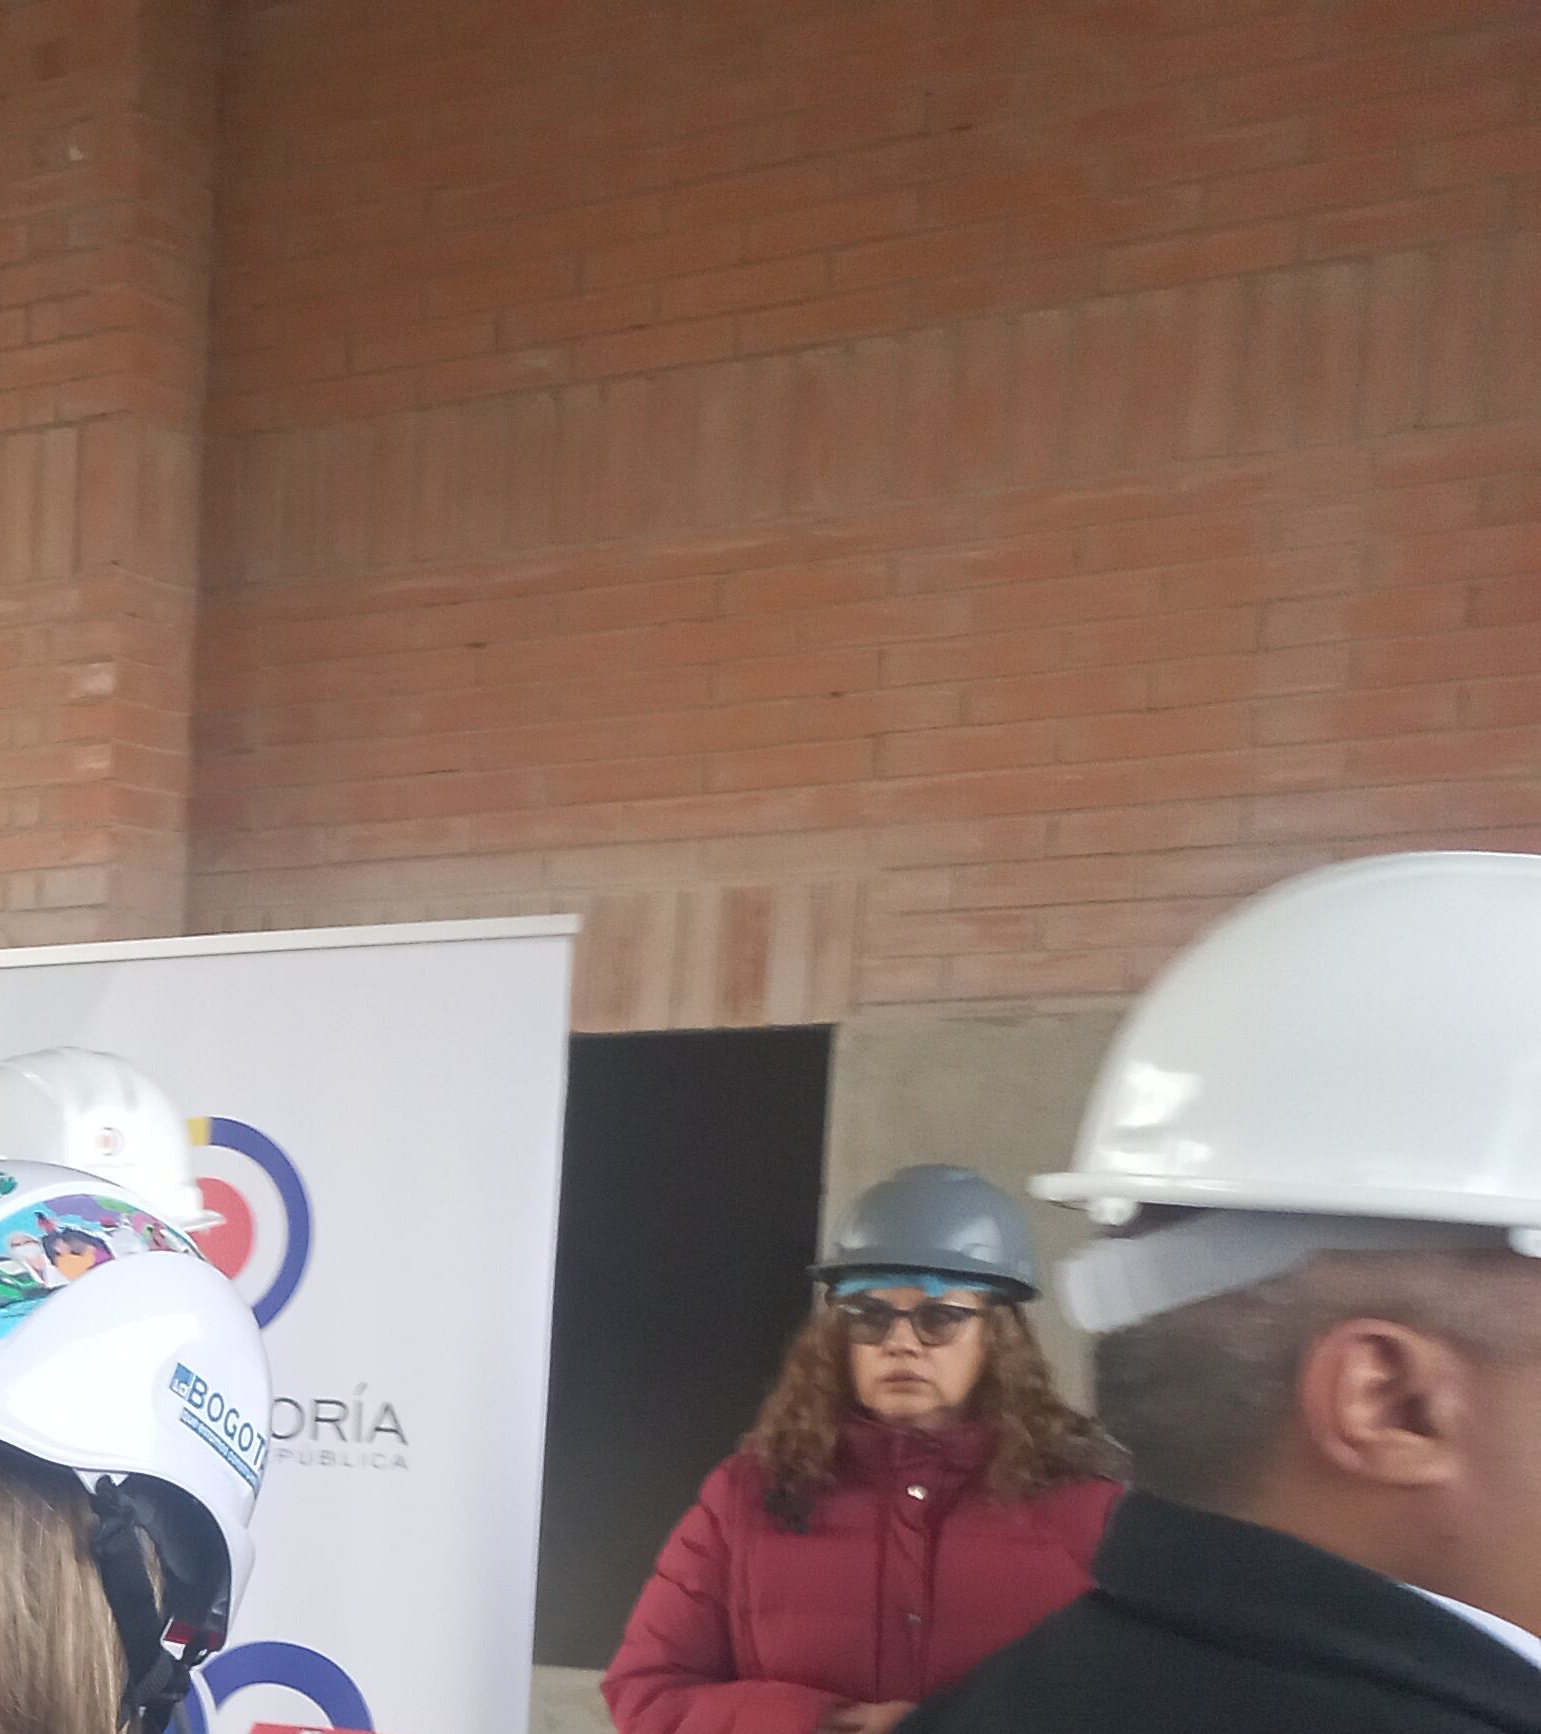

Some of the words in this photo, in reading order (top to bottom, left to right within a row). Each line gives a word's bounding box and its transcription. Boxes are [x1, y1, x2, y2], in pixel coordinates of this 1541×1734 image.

[187, 1375, 266, 1471] BOGOT
[270, 1381, 409, 1446] ORÍA
[276, 1443, 409, 1471] PÚBLICA
